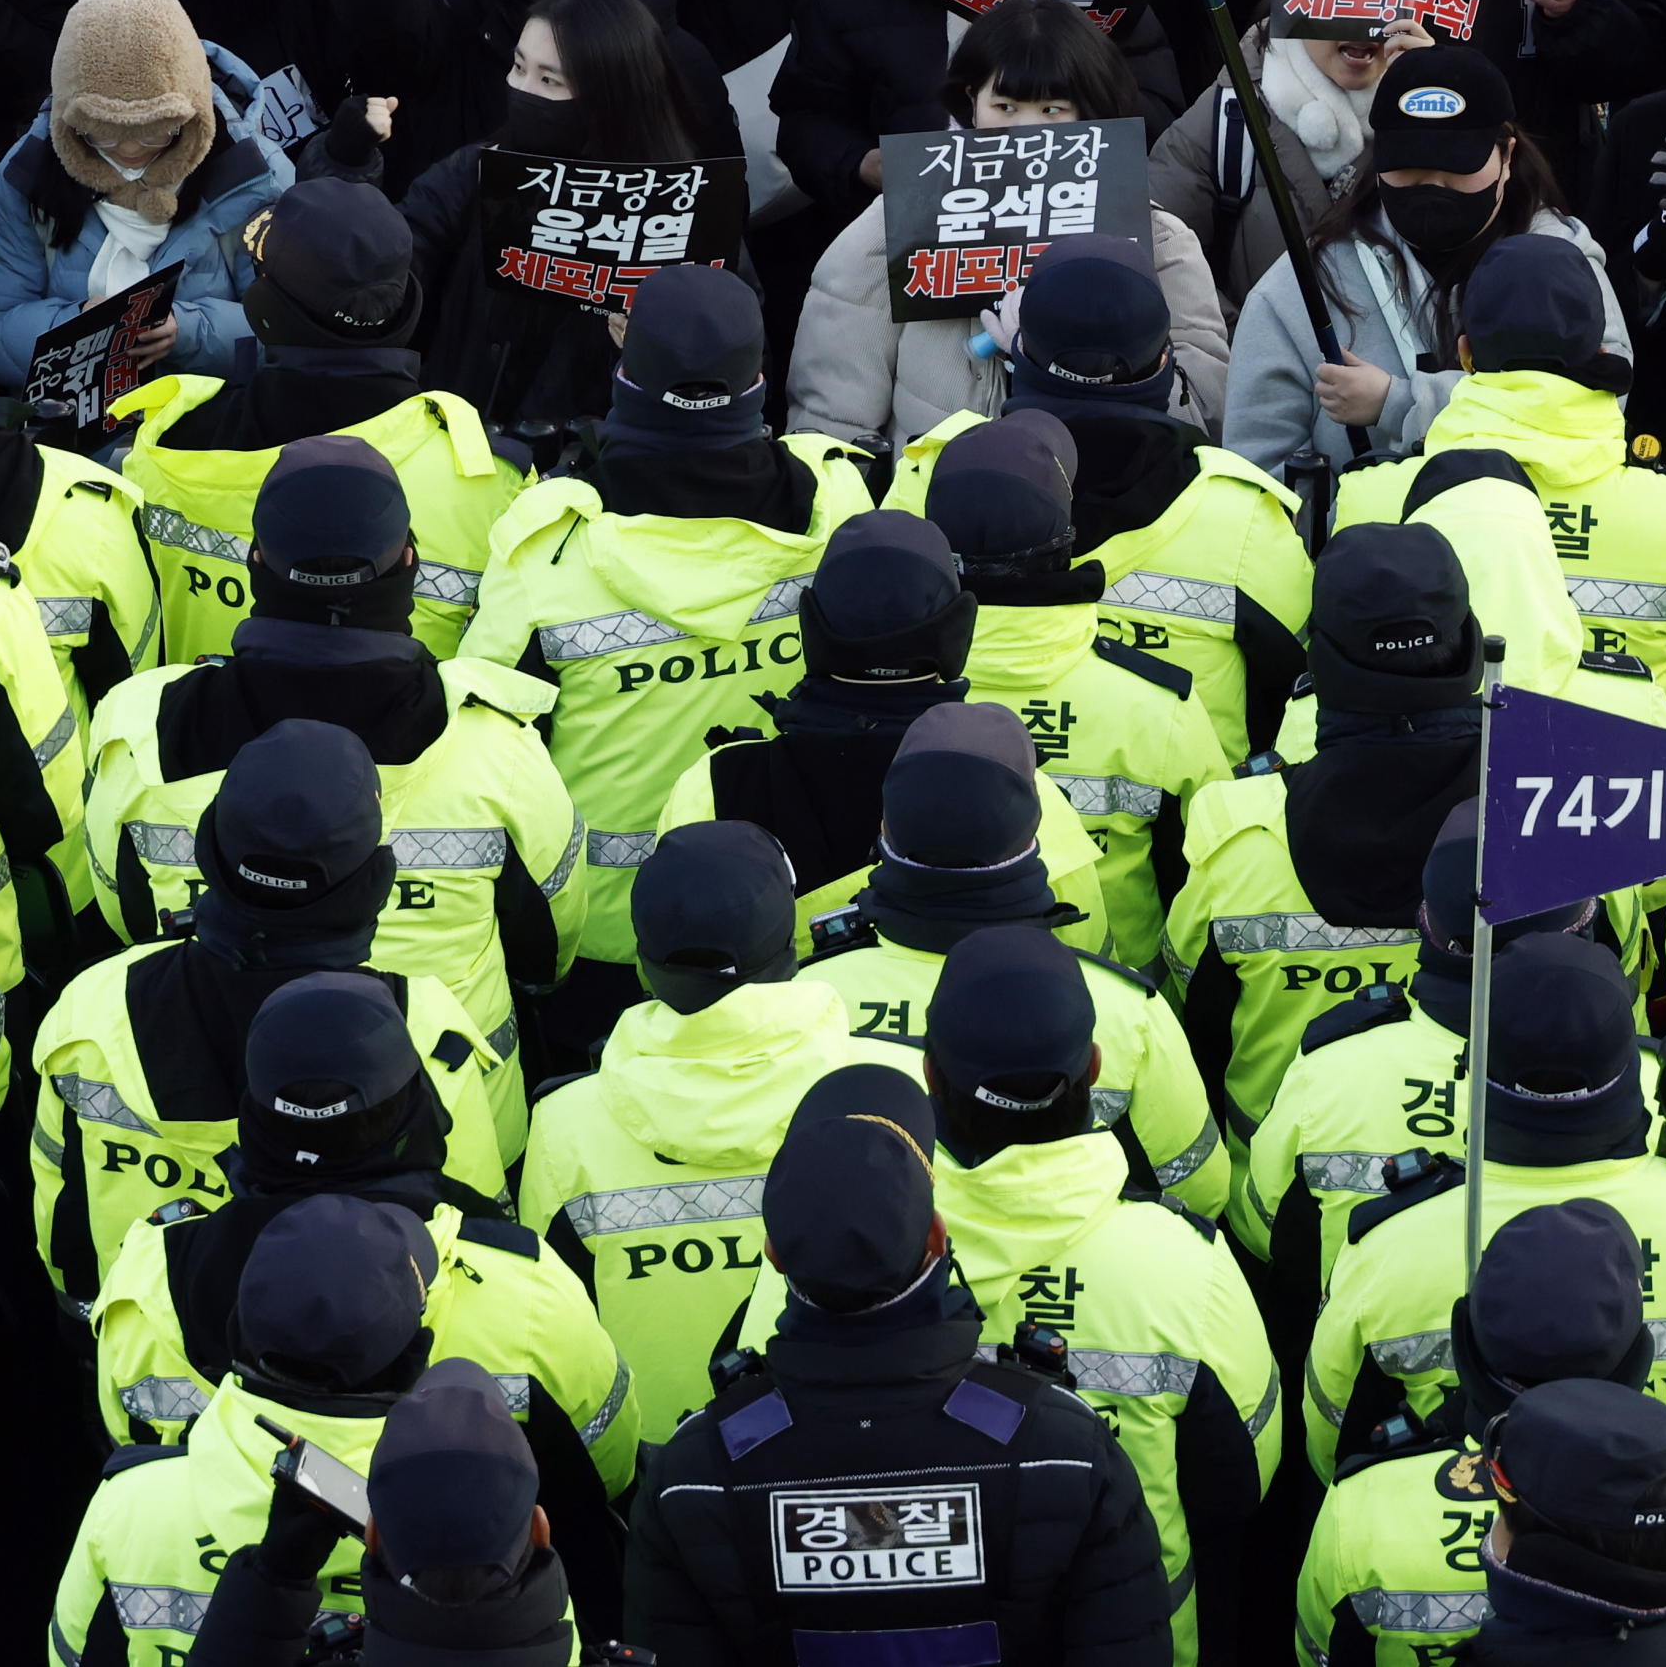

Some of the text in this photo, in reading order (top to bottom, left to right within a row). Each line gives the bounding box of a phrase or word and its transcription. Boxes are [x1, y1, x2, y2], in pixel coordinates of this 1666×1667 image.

[1403, 95, 1462, 115] emis
[922, 132, 1109, 189] 지금당장
[517, 164, 709, 212] 지금당장
[936, 179, 1101, 243] 윤석열
[529, 211, 697, 261] 윤석열
[334, 309, 385, 328] POLICE
[1048, 361, 1114, 386] POLICE
[664, 393, 732, 410] POLICE
[290, 568, 362, 585] POLICE
[1374, 634, 1436, 652] POLICE
[615, 632, 802, 694] POLIC
[239, 864, 307, 891] POLICE
[1281, 960, 1411, 993] POL
[274, 1095, 349, 1121] POLICE
[974, 1083, 1053, 1113] POLICE
[623, 1235, 763, 1281] POL
[802, 1549, 955, 1582] POLICE
